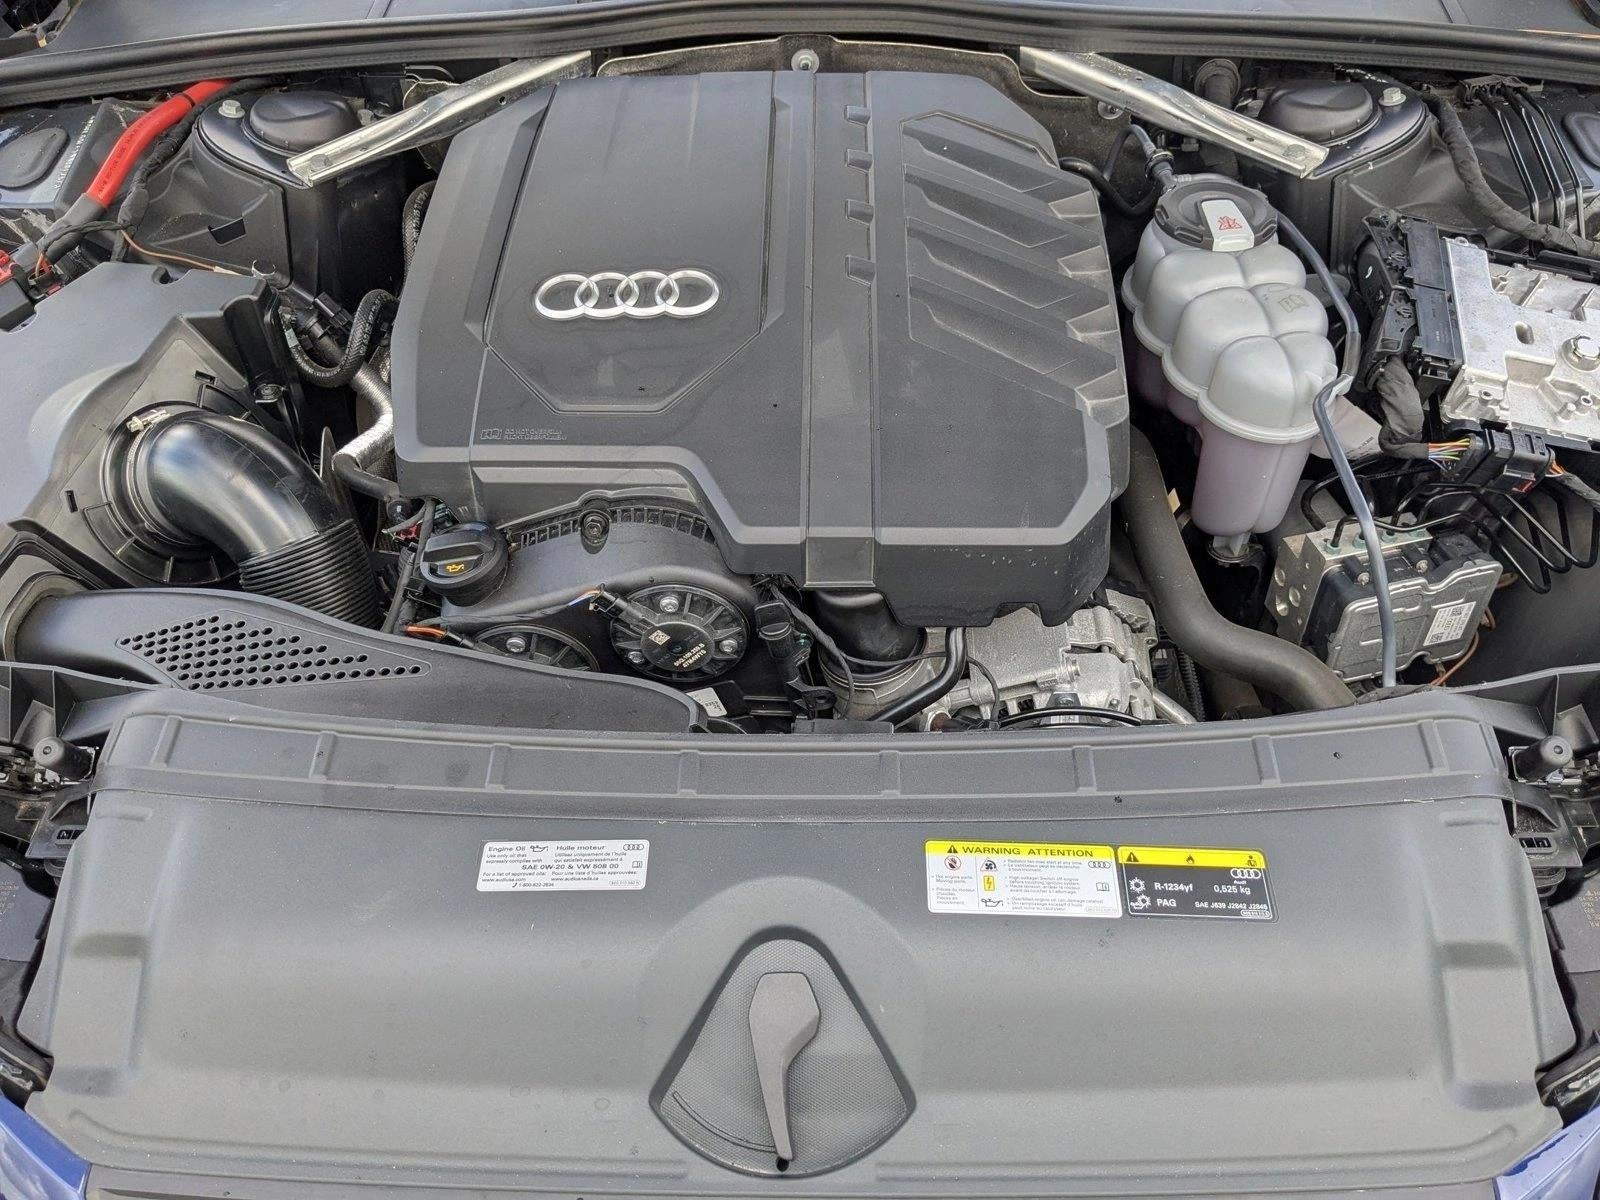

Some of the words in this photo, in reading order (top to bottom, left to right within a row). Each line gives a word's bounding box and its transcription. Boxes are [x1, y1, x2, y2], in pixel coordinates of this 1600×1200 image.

[962, 846, 1021, 855] WARNING
[1028, 848, 1094, 857] ATTENTION
[1154, 882, 1193, 893] R-1234yf
[1213, 884, 1237, 894] 0,525
[1239, 884, 1251, 895] kg
[1157, 898, 1177, 907] PAG
